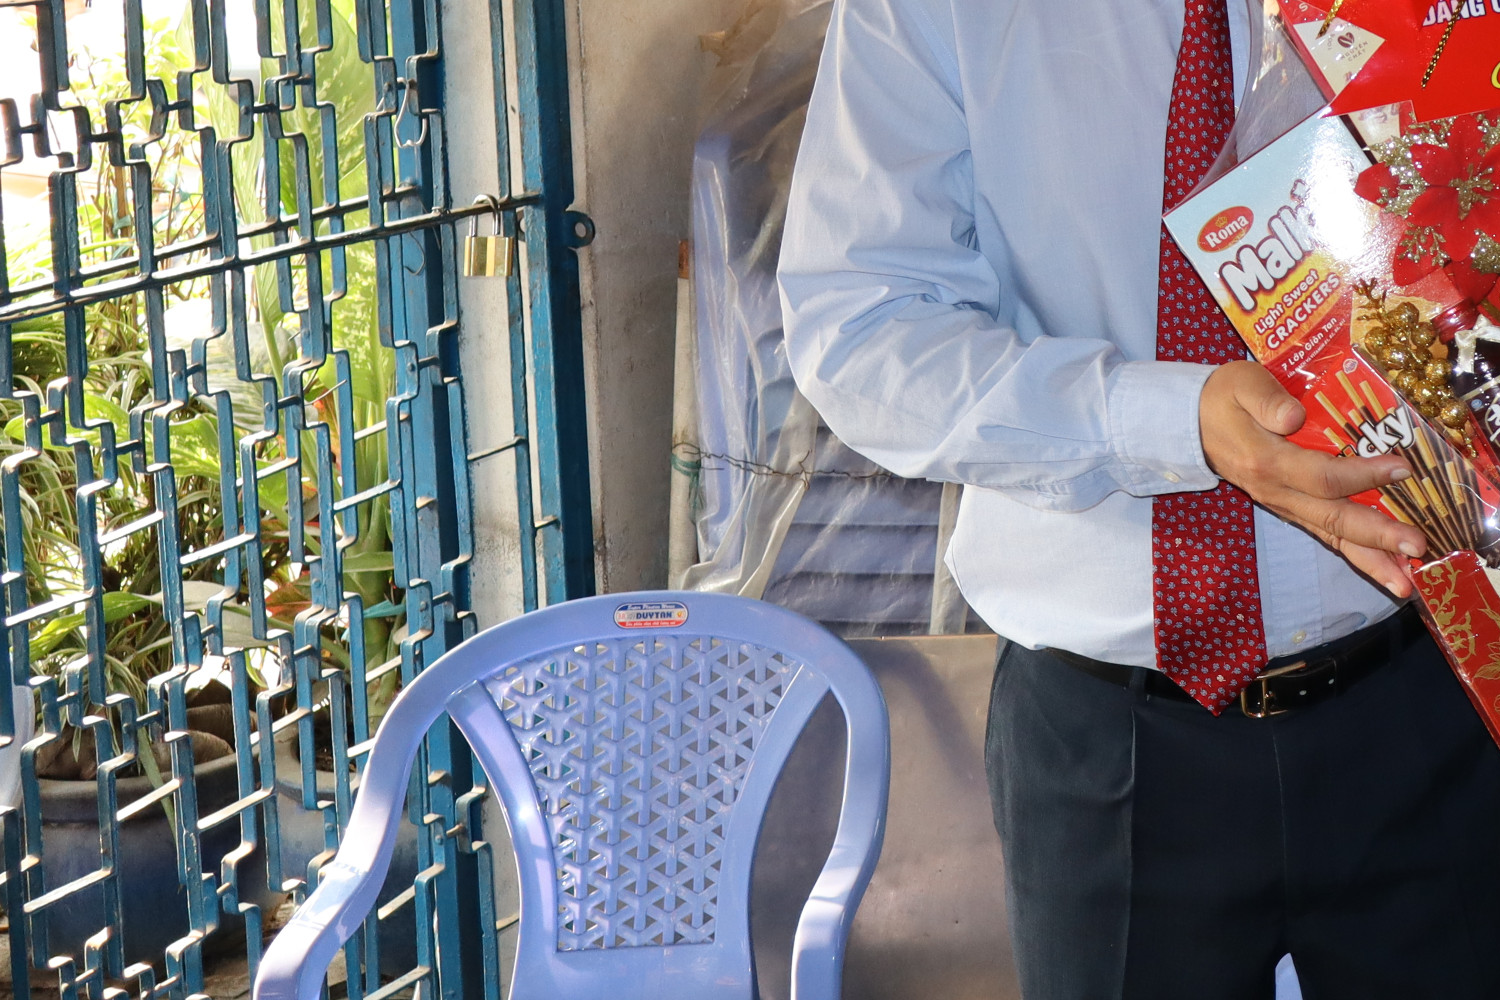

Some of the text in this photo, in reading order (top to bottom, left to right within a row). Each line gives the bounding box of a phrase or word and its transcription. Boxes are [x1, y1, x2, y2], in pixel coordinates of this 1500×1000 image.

[1205, 215, 1249, 248] Roma
[1254, 269, 1320, 335] Light Sweet
[1267, 272, 1341, 349] CRACKERS
[1282, 363, 1288, 371] 7
[1304, 332, 1324, 351] Giòn
[1322, 317, 1337, 333] Tan
[1336, 405, 1414, 458] cky
[636, 611, 672, 620] DUYTAN
